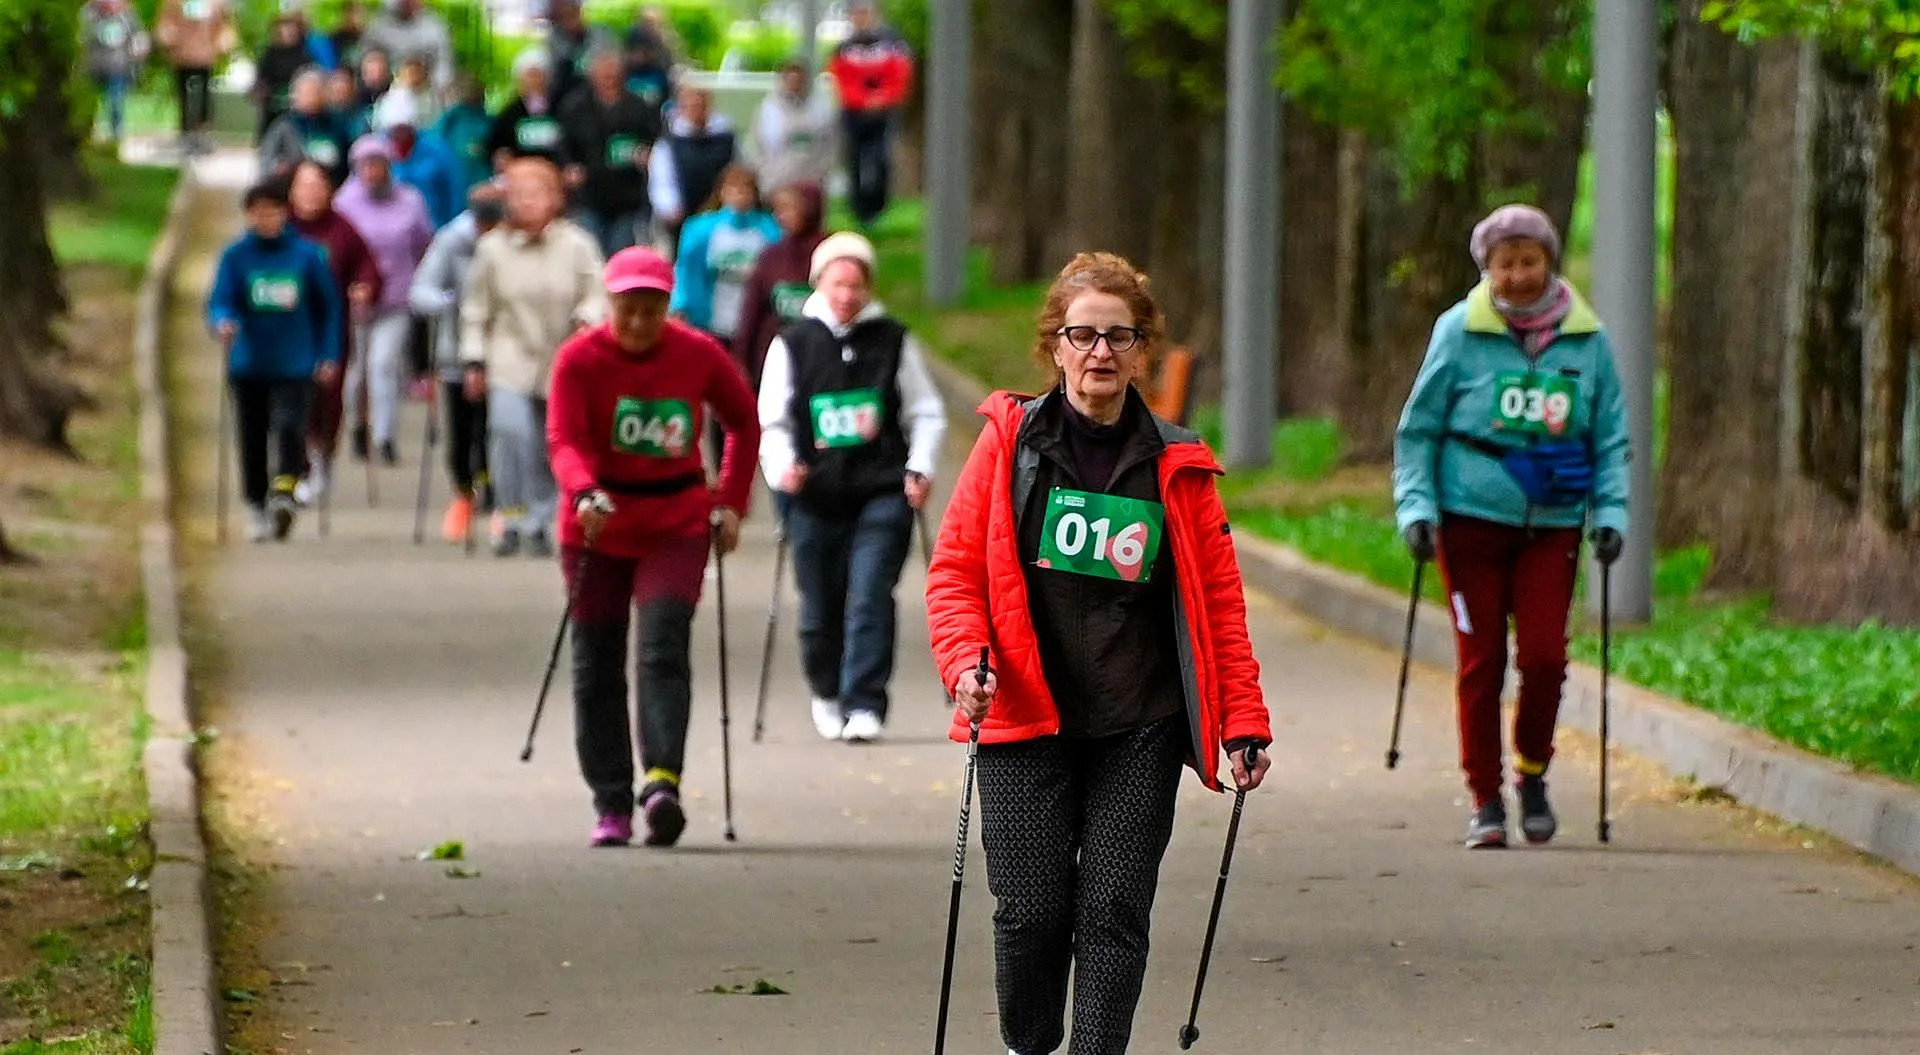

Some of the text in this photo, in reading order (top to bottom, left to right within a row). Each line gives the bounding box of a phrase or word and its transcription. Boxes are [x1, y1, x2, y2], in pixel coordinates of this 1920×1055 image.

[1500, 387, 1570, 425] 039
[618, 413, 685, 447] 042
[1055, 512, 1143, 566] 016
